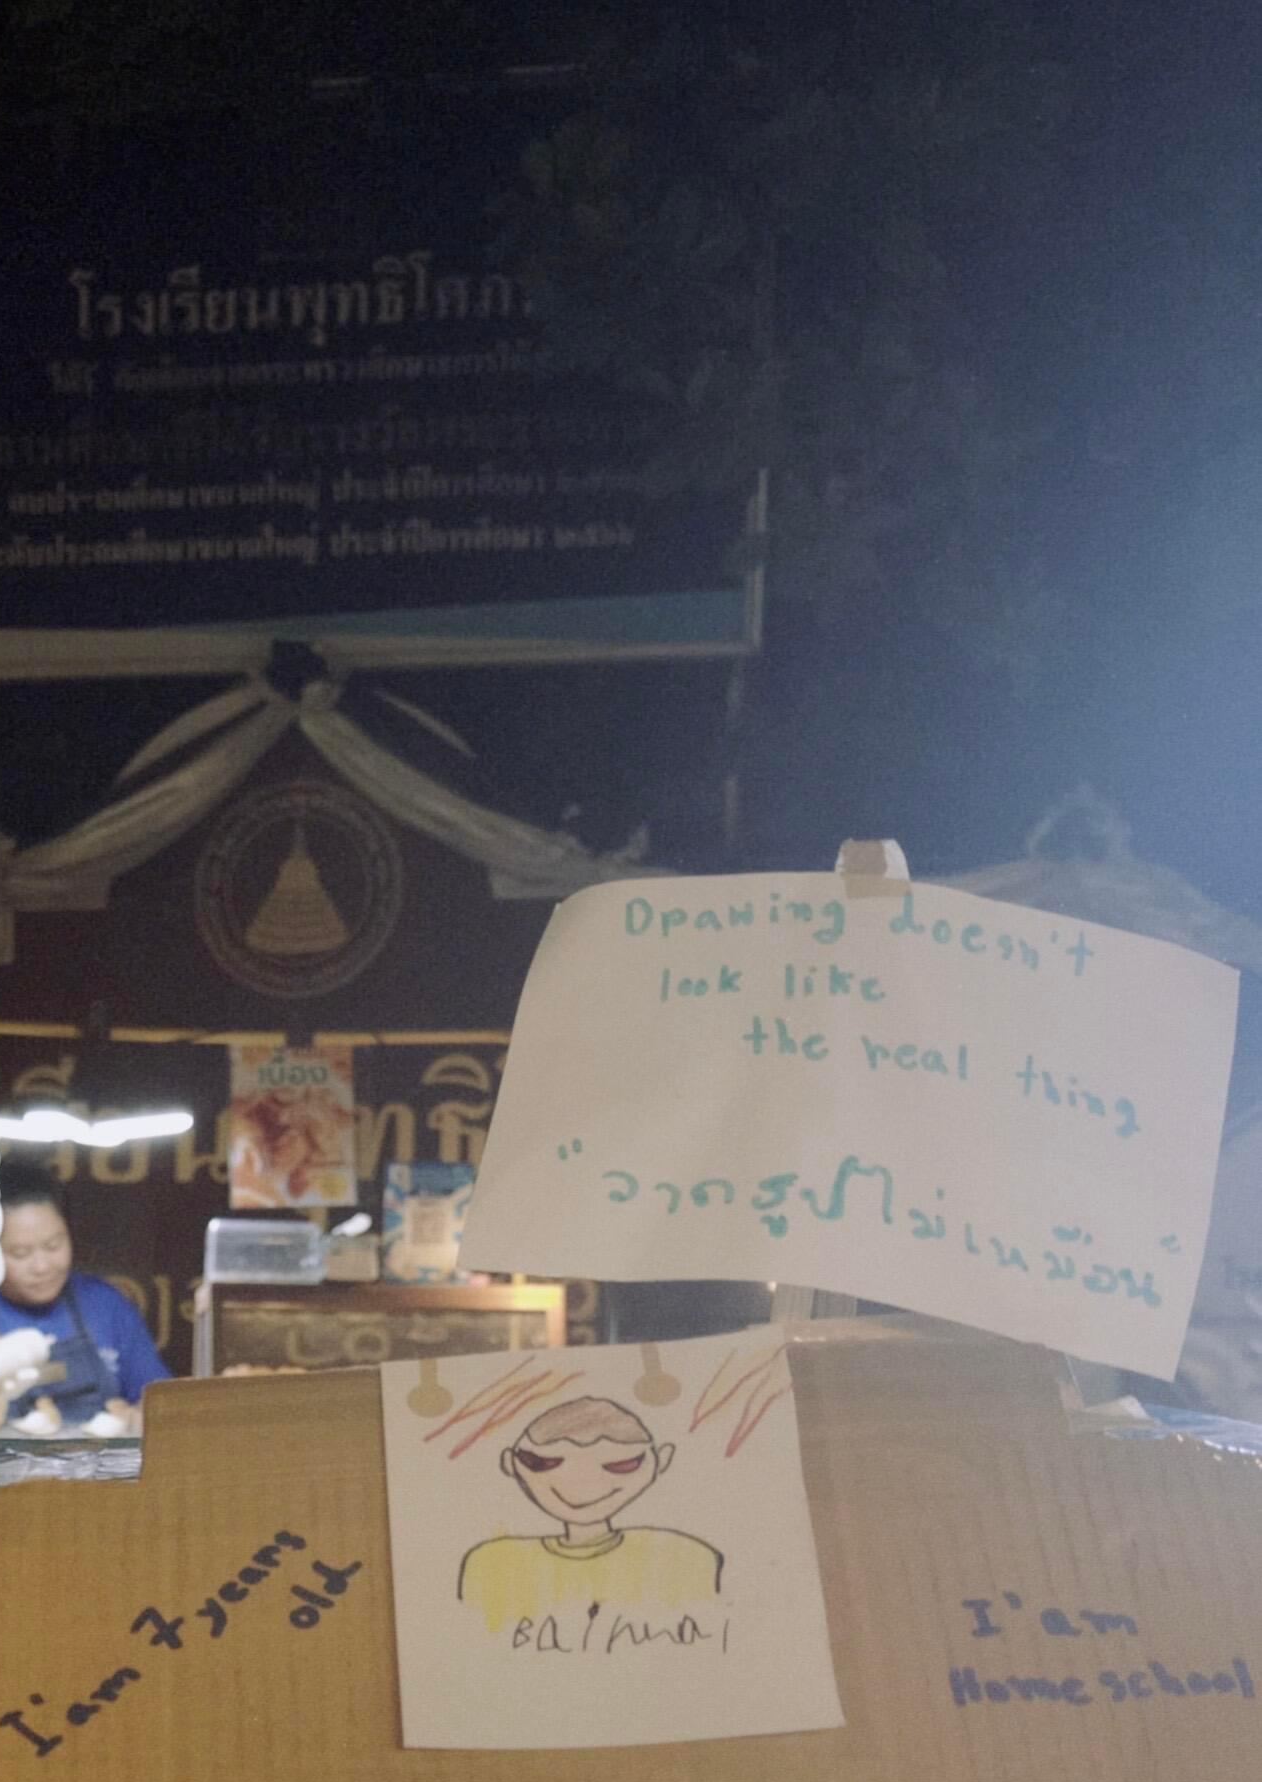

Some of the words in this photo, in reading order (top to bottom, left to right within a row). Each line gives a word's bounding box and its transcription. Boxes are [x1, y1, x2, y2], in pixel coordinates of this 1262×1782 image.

[889, 892, 1094, 977] doesn't
[660, 965, 742, 1002] look
[785, 964, 886, 1001] like
[743, 1016, 829, 1061] the
[862, 1035, 968, 1080] real
[1017, 1055, 1140, 1138] thing
[131, 1606, 184, 1650] 7
[197, 1530, 306, 1638] years
[289, 1560, 363, 1629] old
